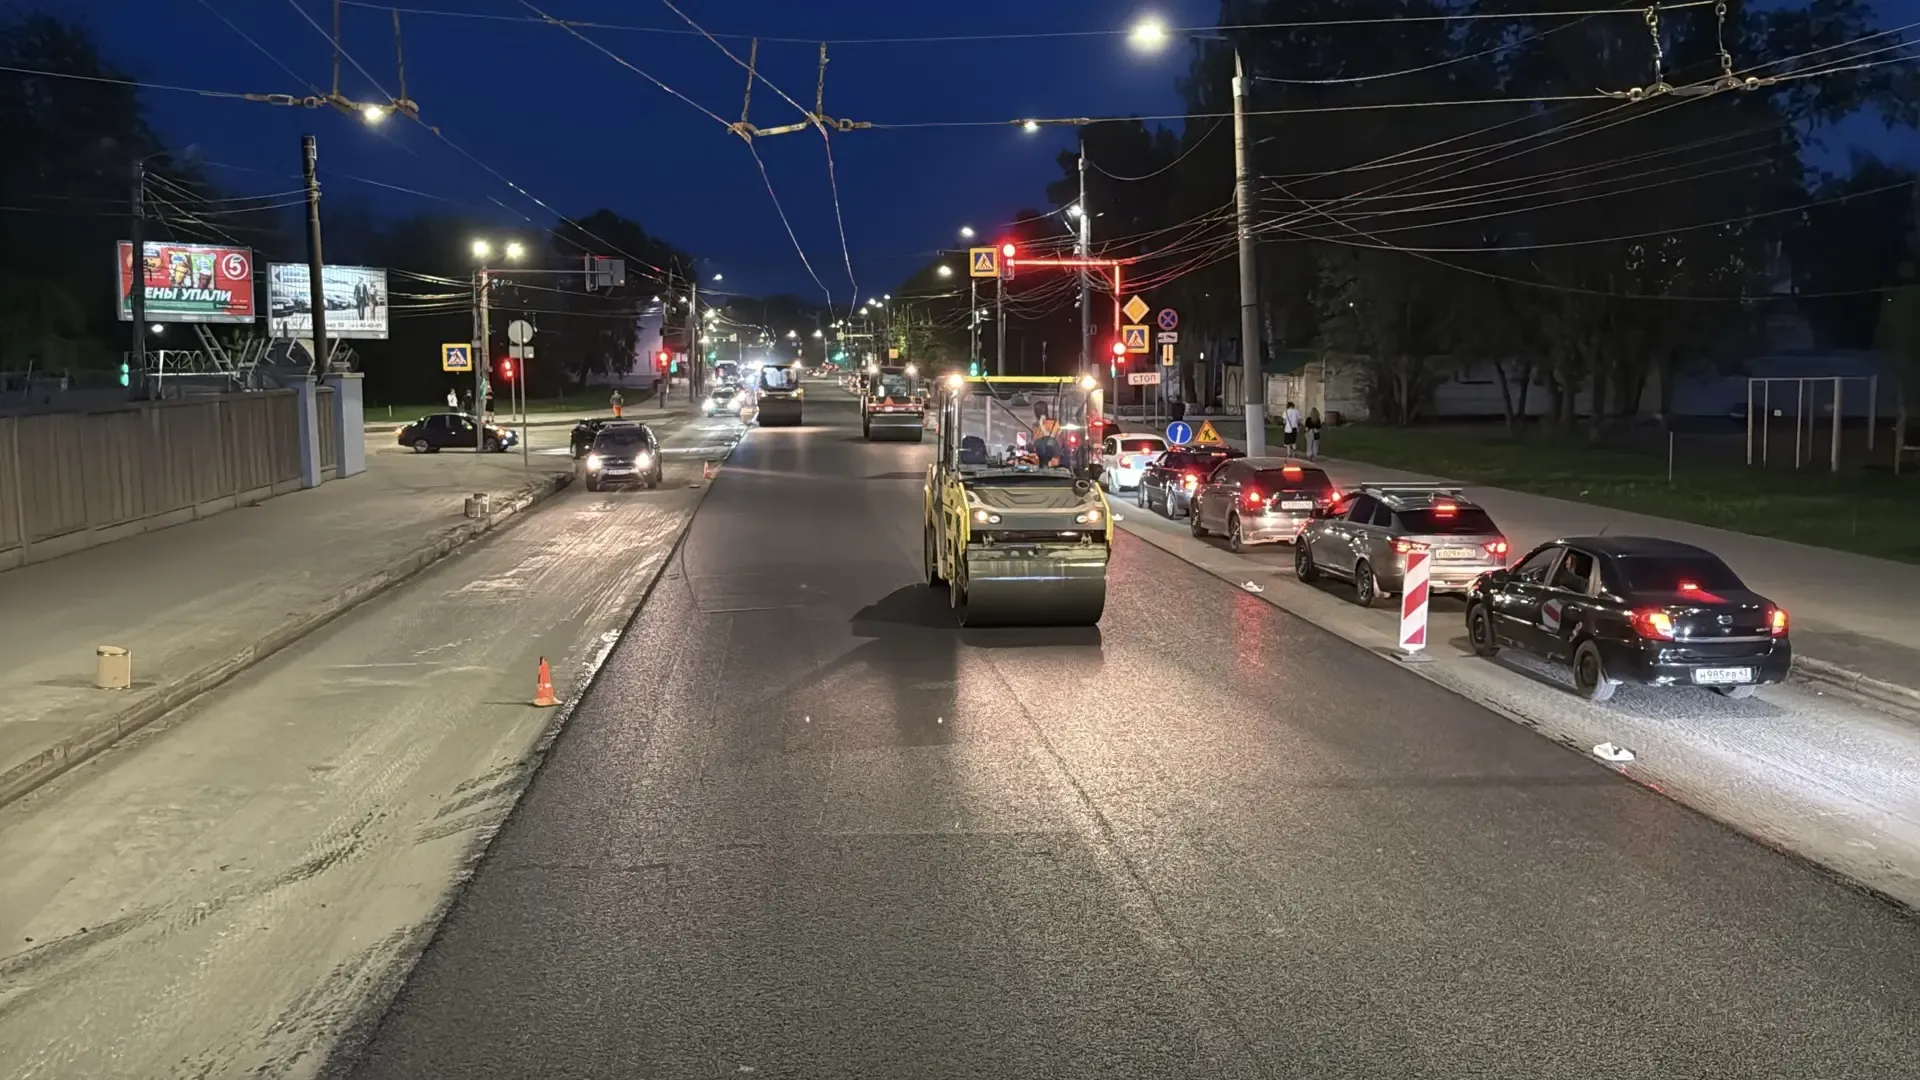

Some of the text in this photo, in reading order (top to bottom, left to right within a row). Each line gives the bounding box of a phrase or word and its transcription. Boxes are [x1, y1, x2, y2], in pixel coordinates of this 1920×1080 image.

[228, 255, 242, 276] 5
[144, 286, 232, 302] ЕНЫ УПАЛИ
[1132, 374, 1156, 383] СТОП
